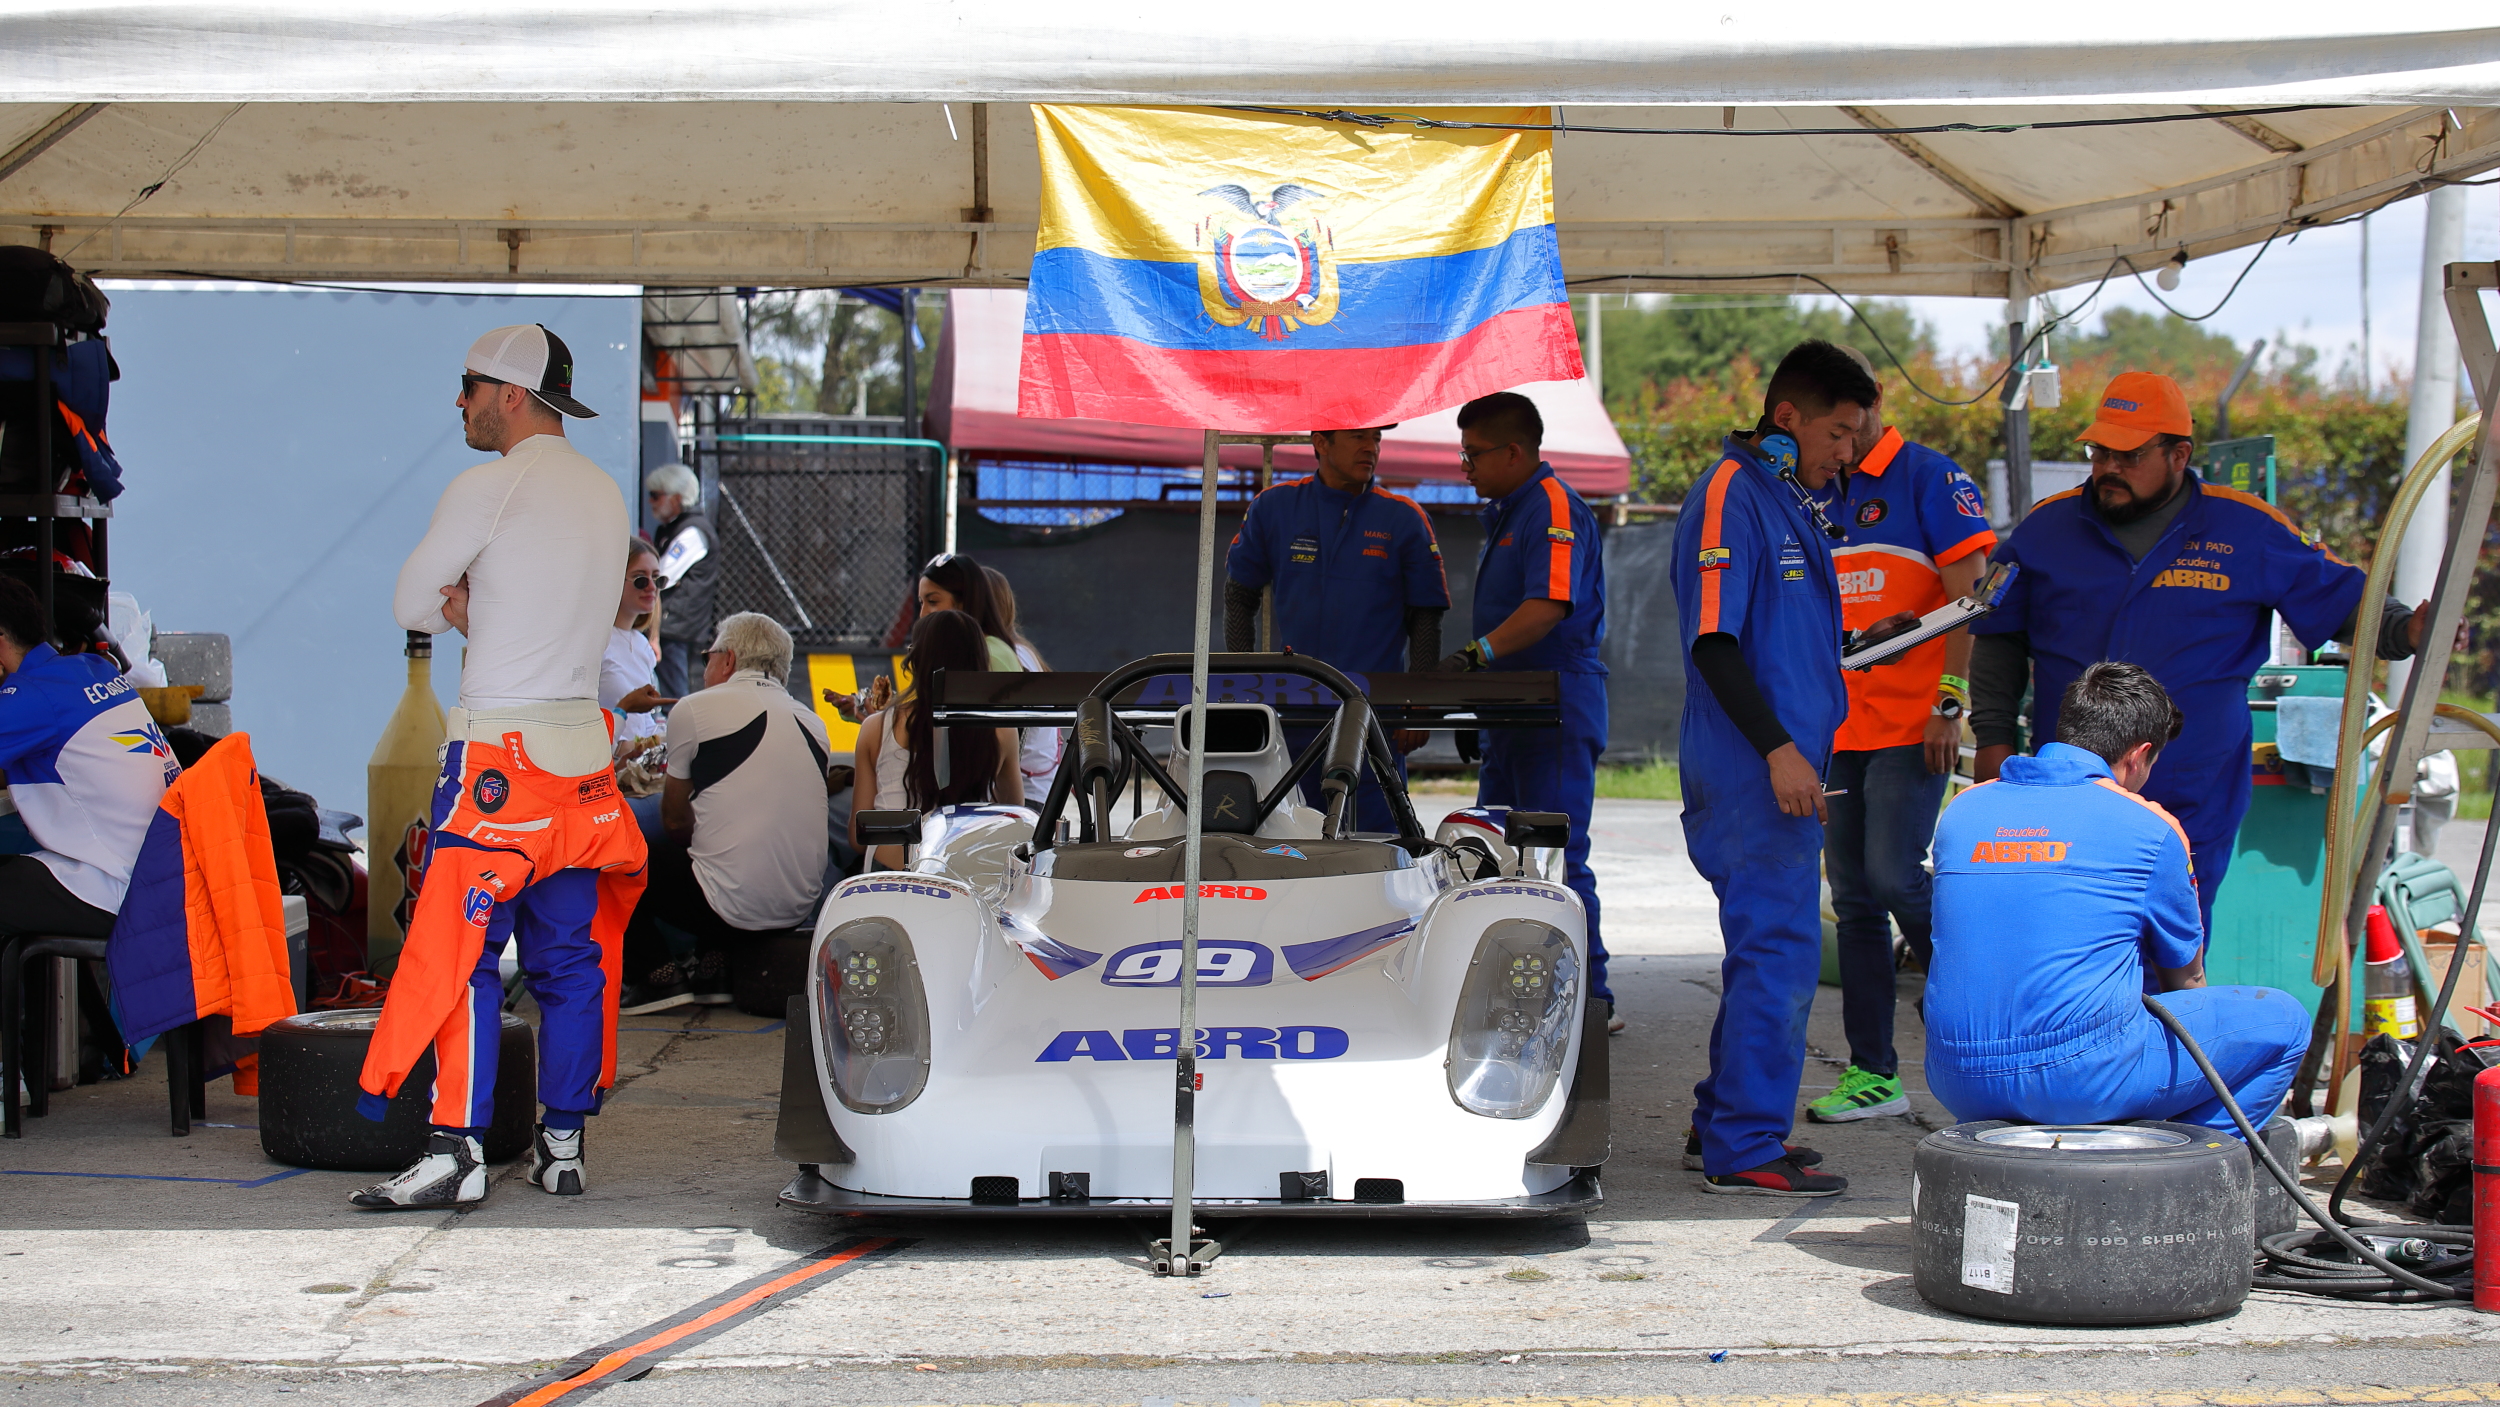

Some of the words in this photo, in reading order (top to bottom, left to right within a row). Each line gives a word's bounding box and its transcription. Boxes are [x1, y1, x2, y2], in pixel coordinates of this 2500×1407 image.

[2103, 397, 2138, 412] ABRO
[2205, 541, 2234, 555] PATO
[2169, 557, 2221, 570] scudería
[1836, 567, 1885, 595] BRO
[2151, 569, 2231, 591] ABRO
[1843, 594, 1882, 604] WORLDWIDE
[593, 808, 621, 825] HRX
[1995, 825, 2050, 837] Escudería
[1970, 841, 2067, 863] ABRO
[839, 883, 951, 899] ABRO
[1133, 884, 1267, 904] ABRO
[1454, 886, 1566, 902] ABRO
[1108, 947, 1257, 983] 99
[1034, 1026, 1349, 1062] ABRO
[2087, 1237, 2128, 1246] G66
[2142, 1233, 2195, 1245] 09B13
[1969, 1269, 1991, 1279] B117
